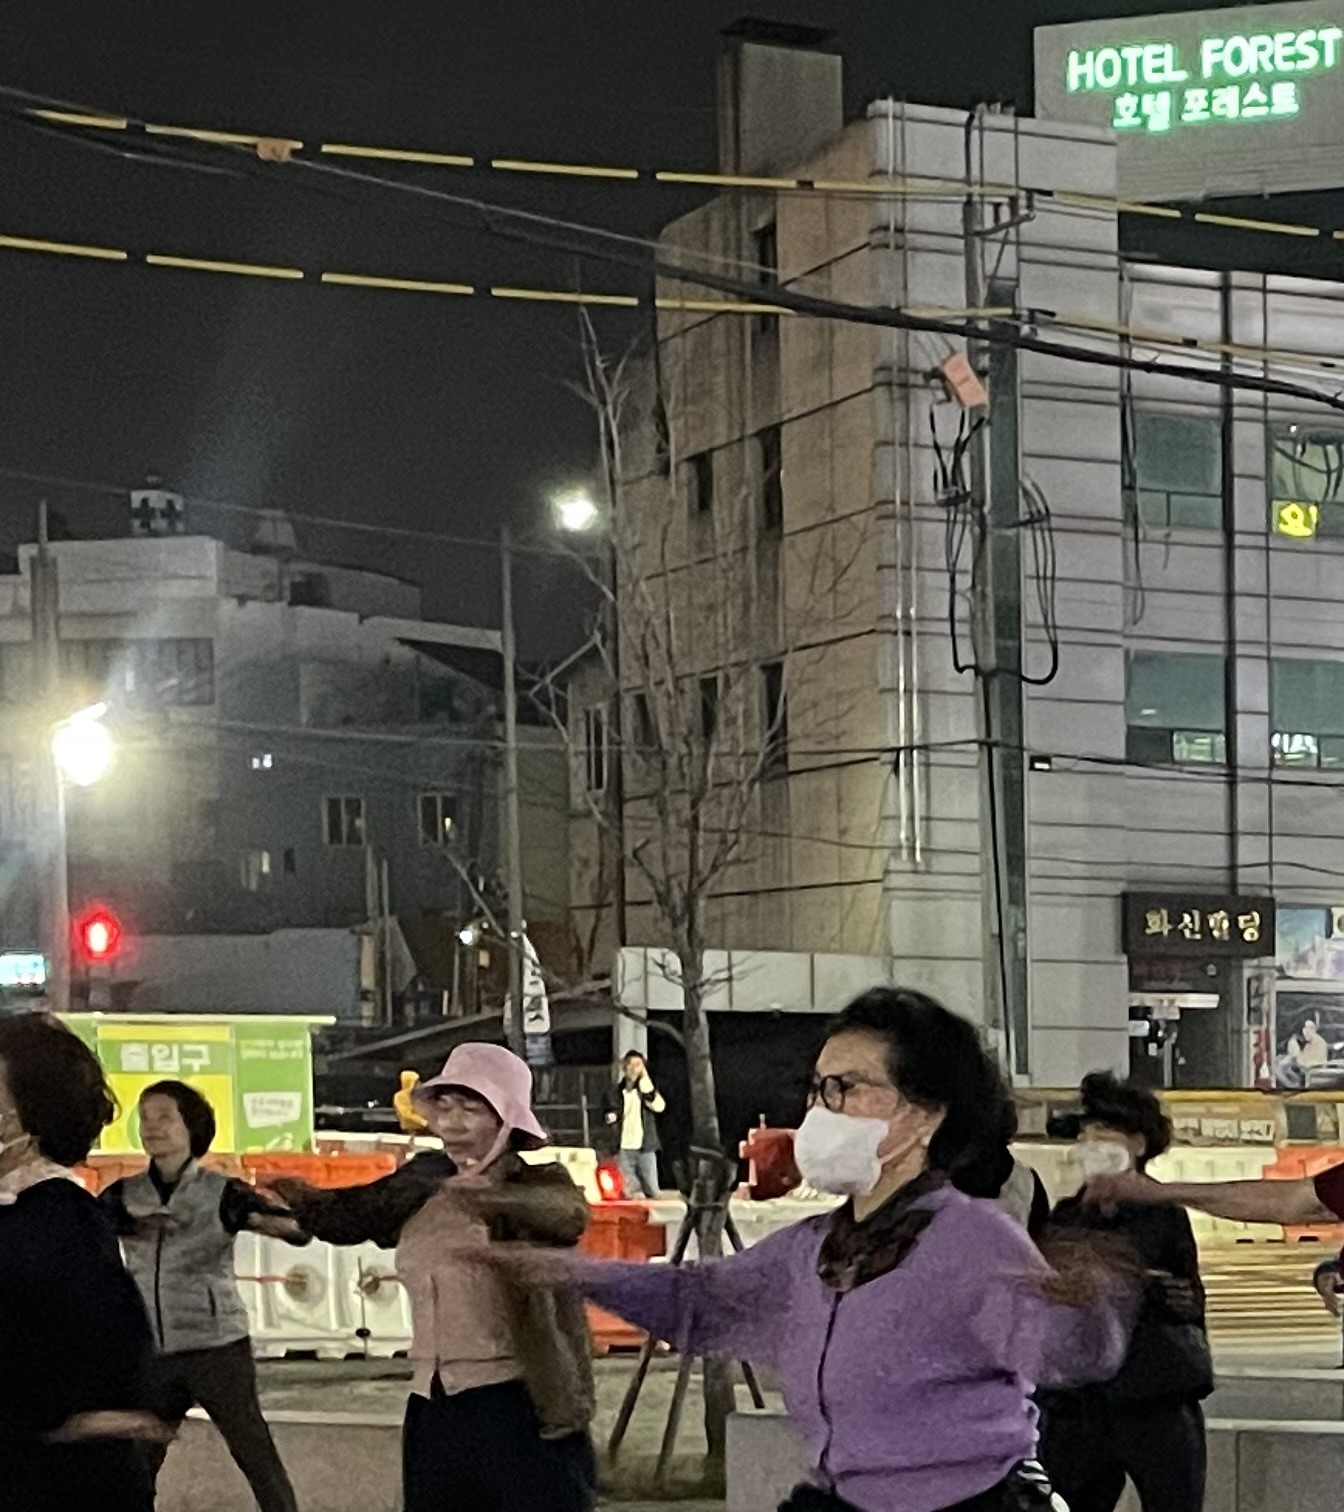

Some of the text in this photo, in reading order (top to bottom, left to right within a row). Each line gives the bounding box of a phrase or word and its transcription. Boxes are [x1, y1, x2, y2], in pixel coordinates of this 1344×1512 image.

[1066, 27, 1344, 91] HOTEL FOREST
[1113, 81, 1299, 132] 호텔 포레스트
